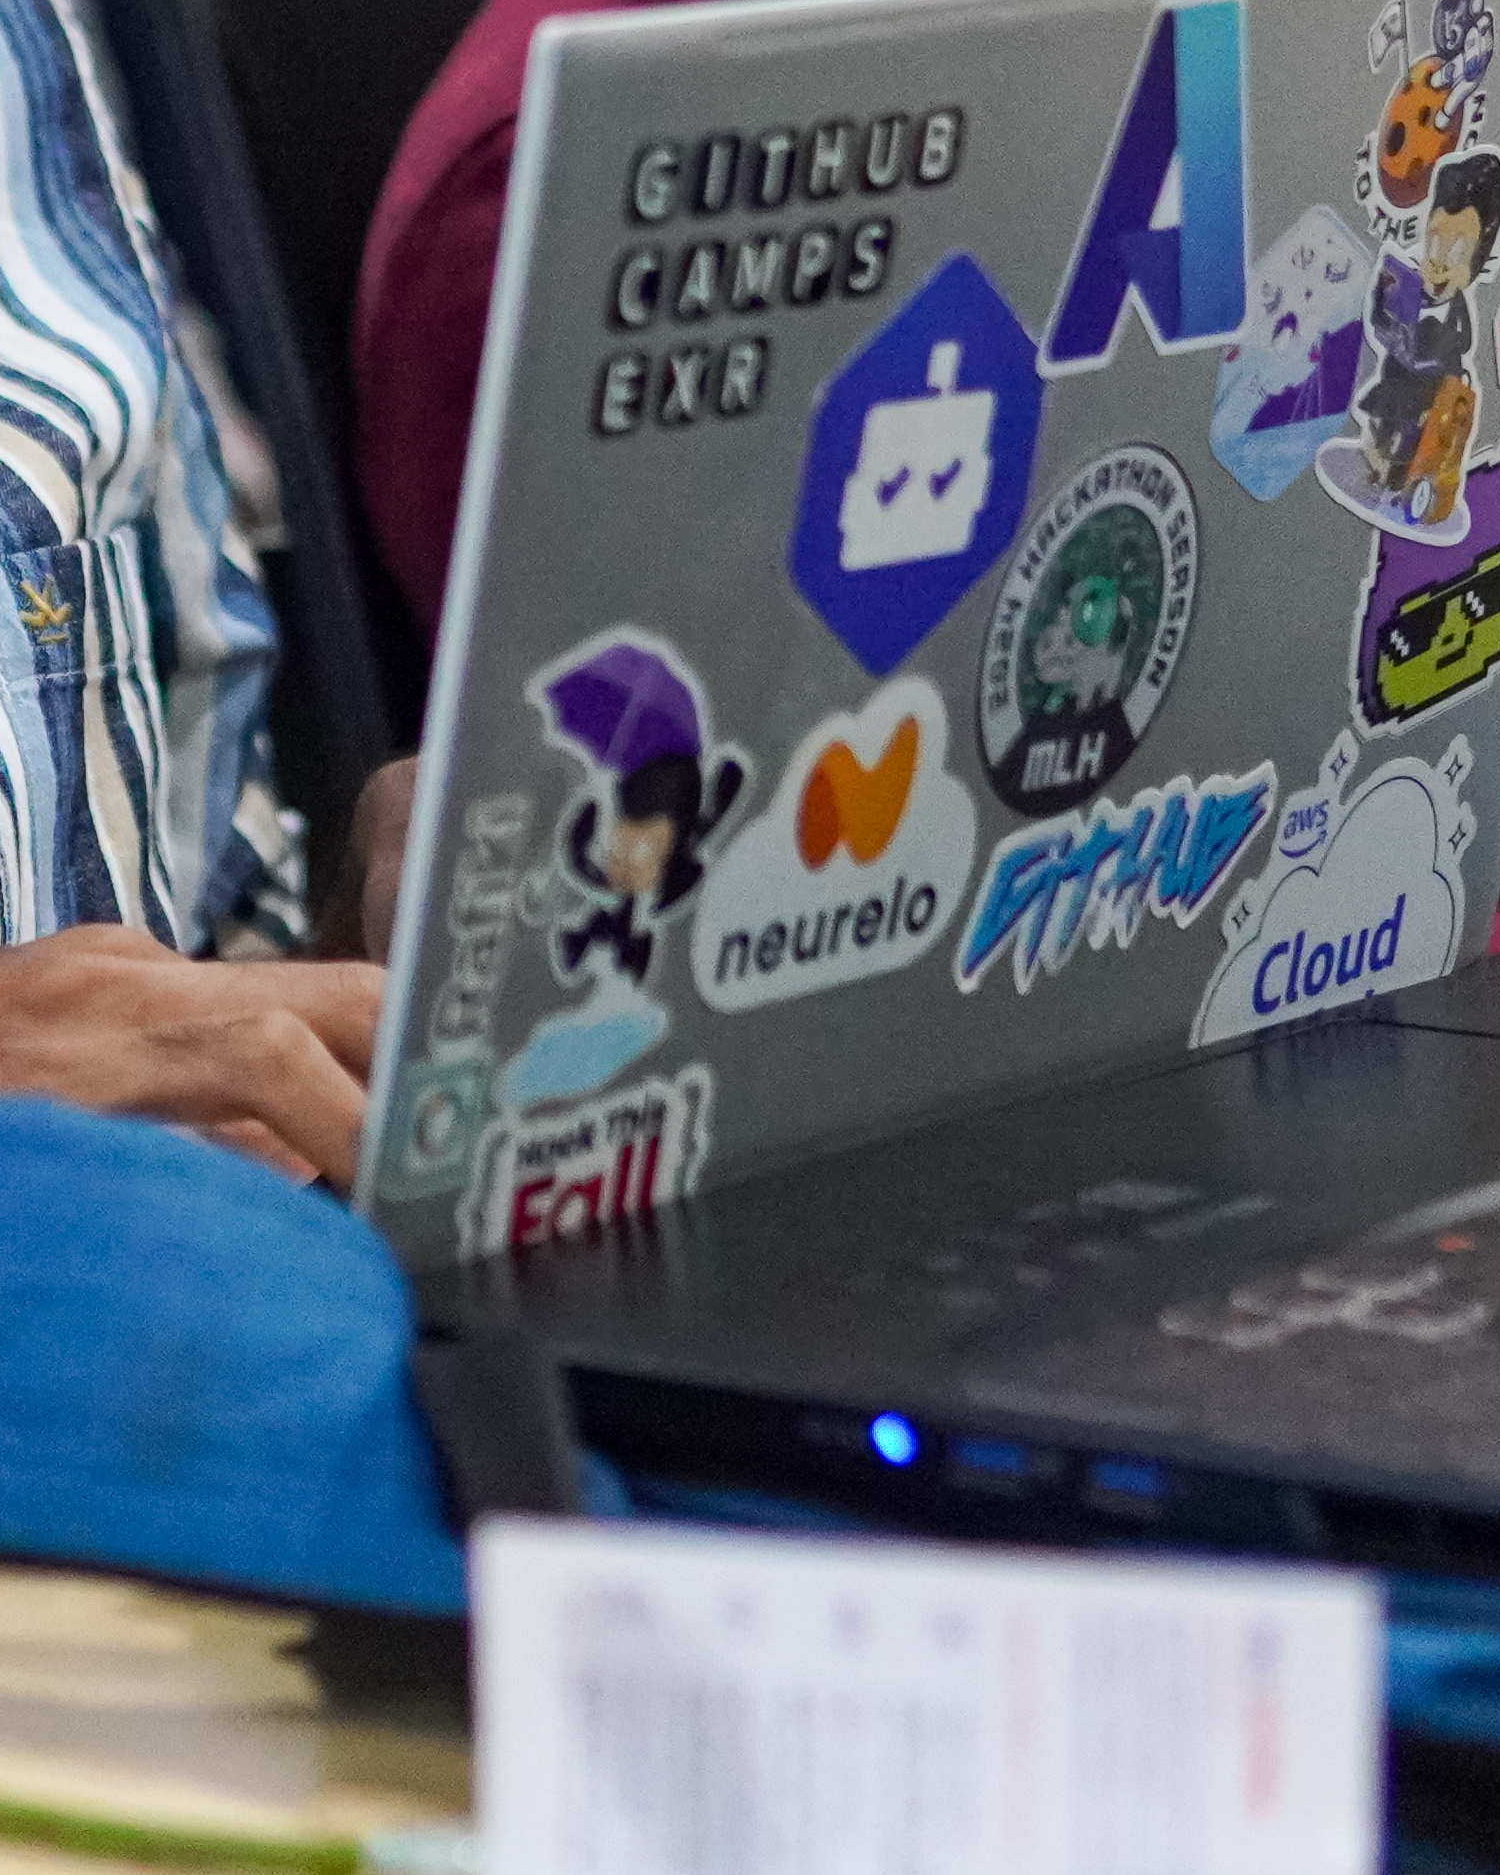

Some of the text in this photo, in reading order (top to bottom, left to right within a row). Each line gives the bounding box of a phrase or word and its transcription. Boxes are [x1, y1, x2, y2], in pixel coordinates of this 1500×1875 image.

[629, 107, 961, 224] GITHUB
[612, 221, 890, 327] CAMPS
[1371, 206, 1420, 242] THE
[597, 337, 767, 434] EXR
[1019, 457, 1178, 583] HACKATHON
[1146, 508, 1194, 690] SEASON
[1020, 731, 1108, 793] MLH
[1283, 798, 1330, 841] aws
[715, 876, 937, 985] neurelo
[1251, 892, 1407, 1014] Cloud
